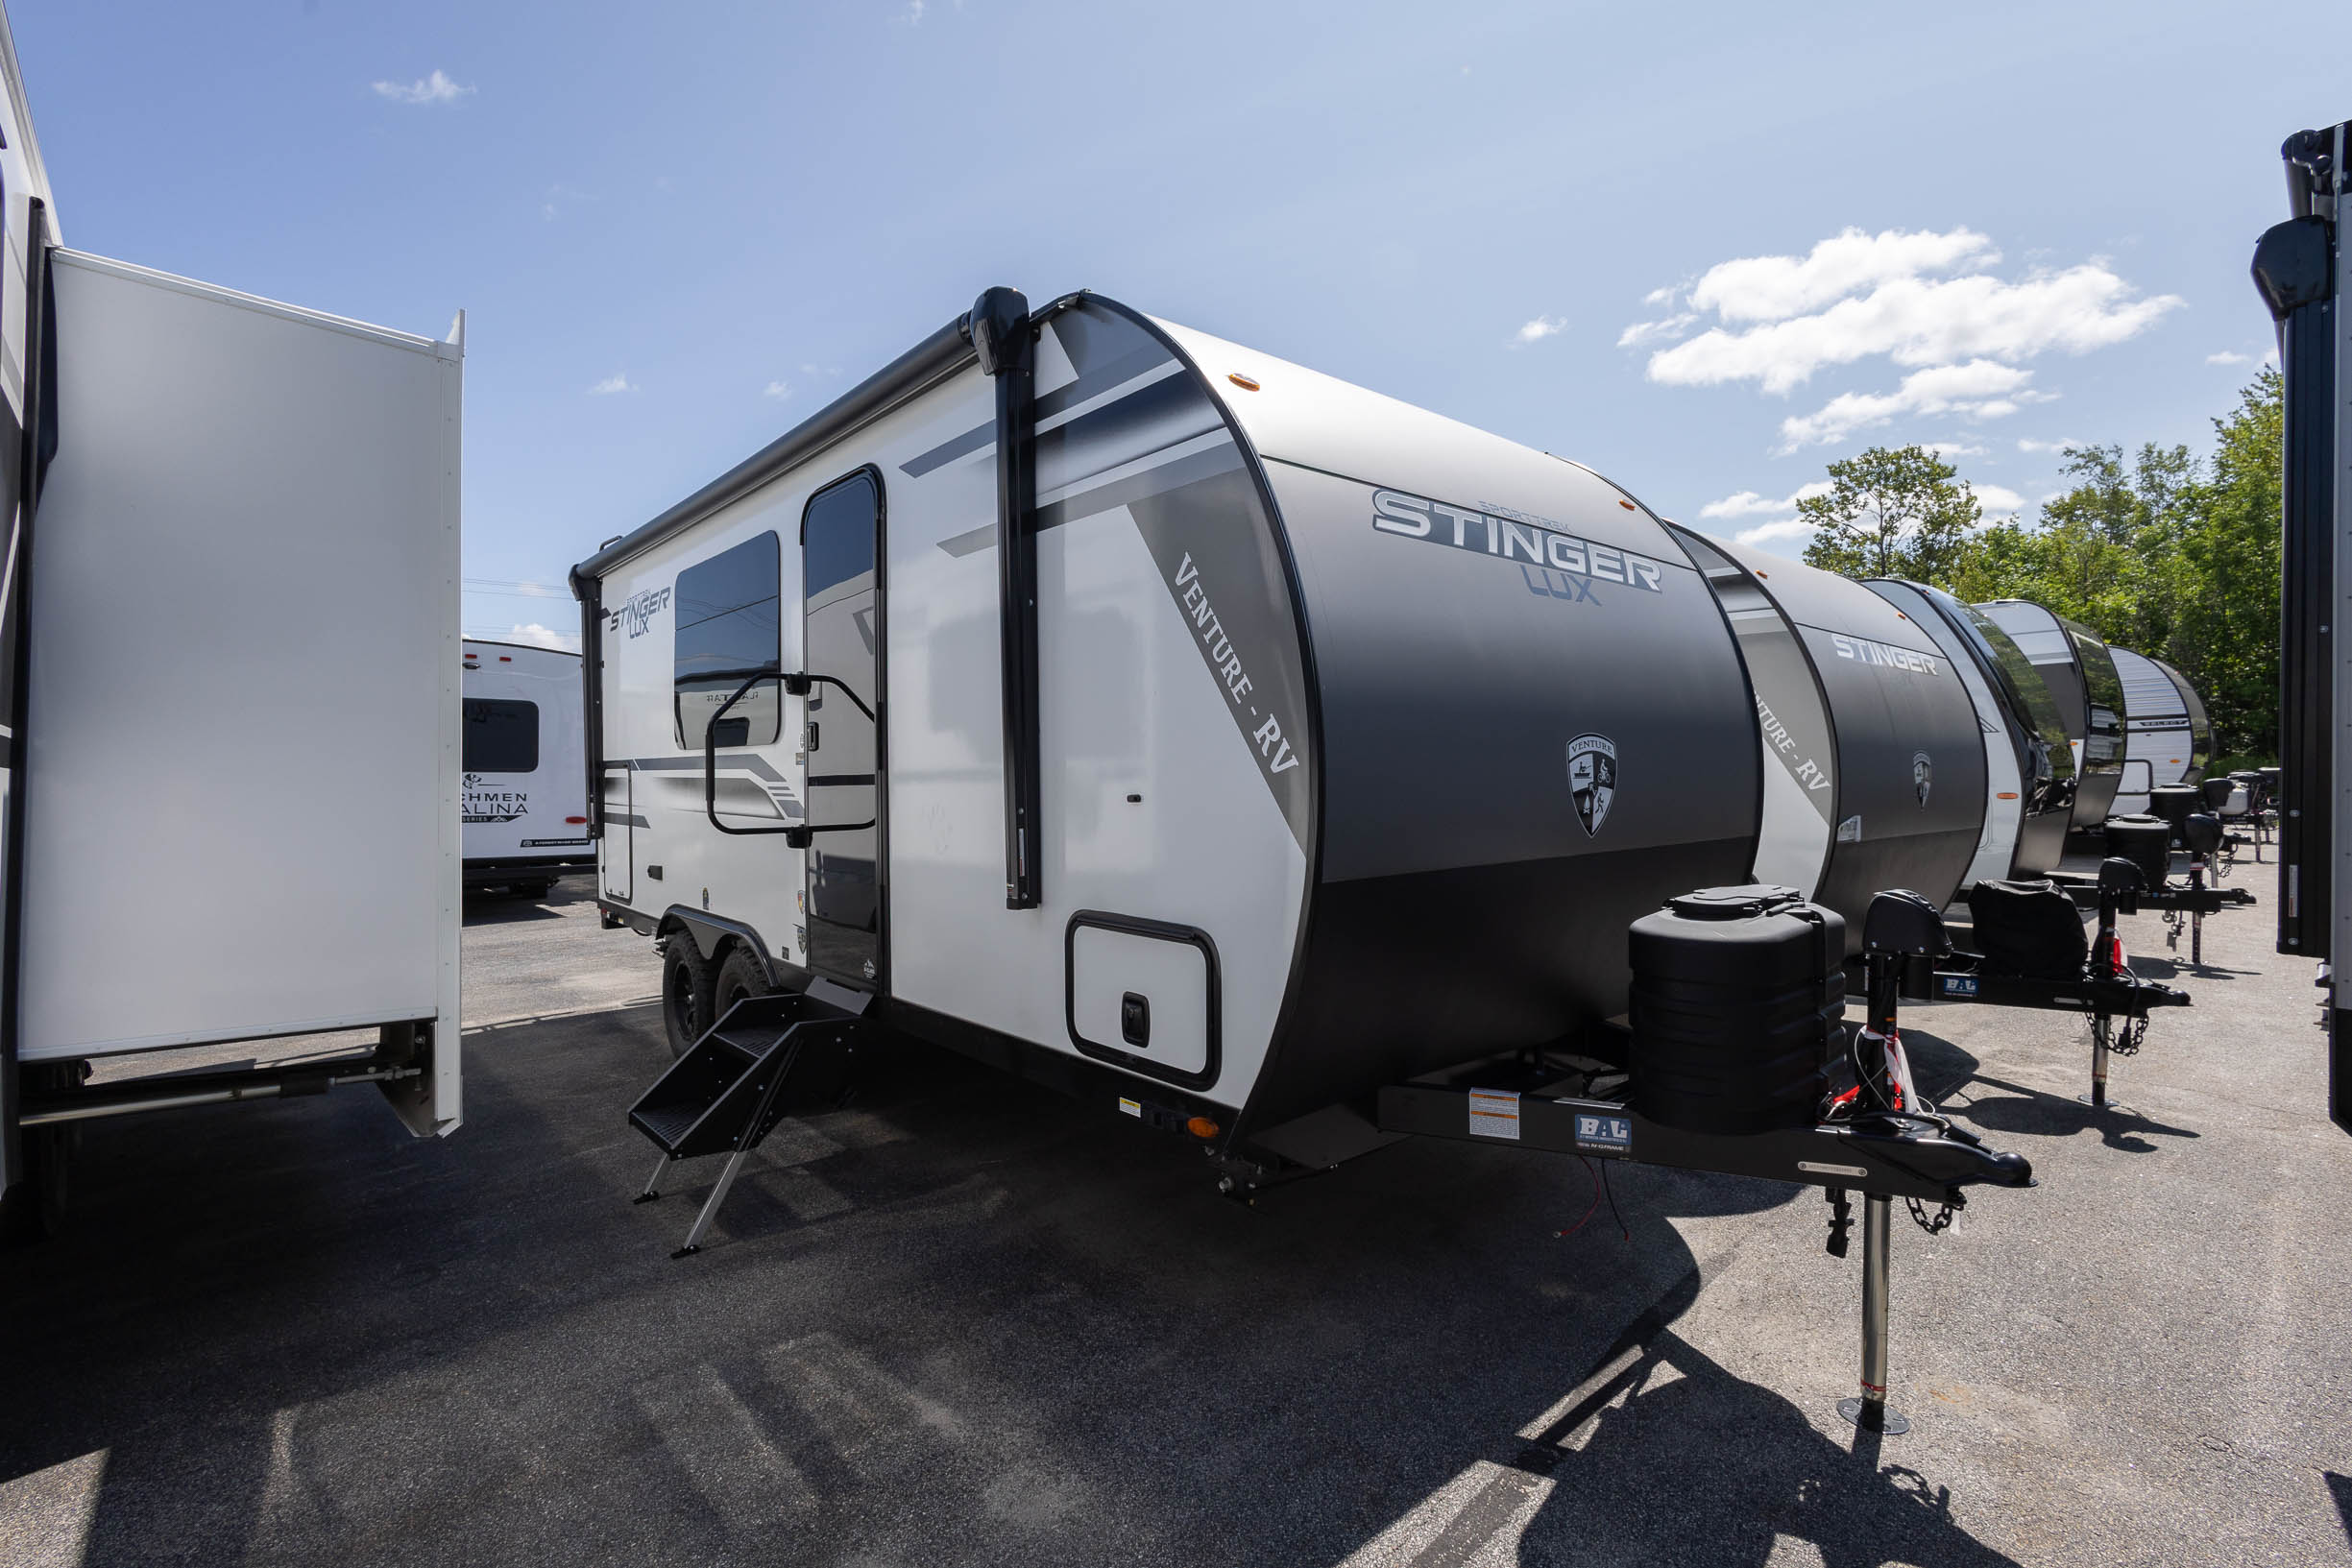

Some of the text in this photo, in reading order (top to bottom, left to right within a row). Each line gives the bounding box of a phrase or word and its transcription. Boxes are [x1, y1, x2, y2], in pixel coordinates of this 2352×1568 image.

[1371, 489, 1662, 593] STINGER
[1520, 564, 1603, 607] LUX
[610, 586, 671, 632] STINGER
[629, 615, 649, 639] LUX
[1175, 551, 1253, 705] VENTURE
[1253, 713, 1299, 774] RV
[1831, 633, 1939, 676] STINGER
[1571, 739, 1613, 755] VENTURE
[1795, 759, 1831, 790] RV
[1579, 1117, 1628, 1139] BAL
